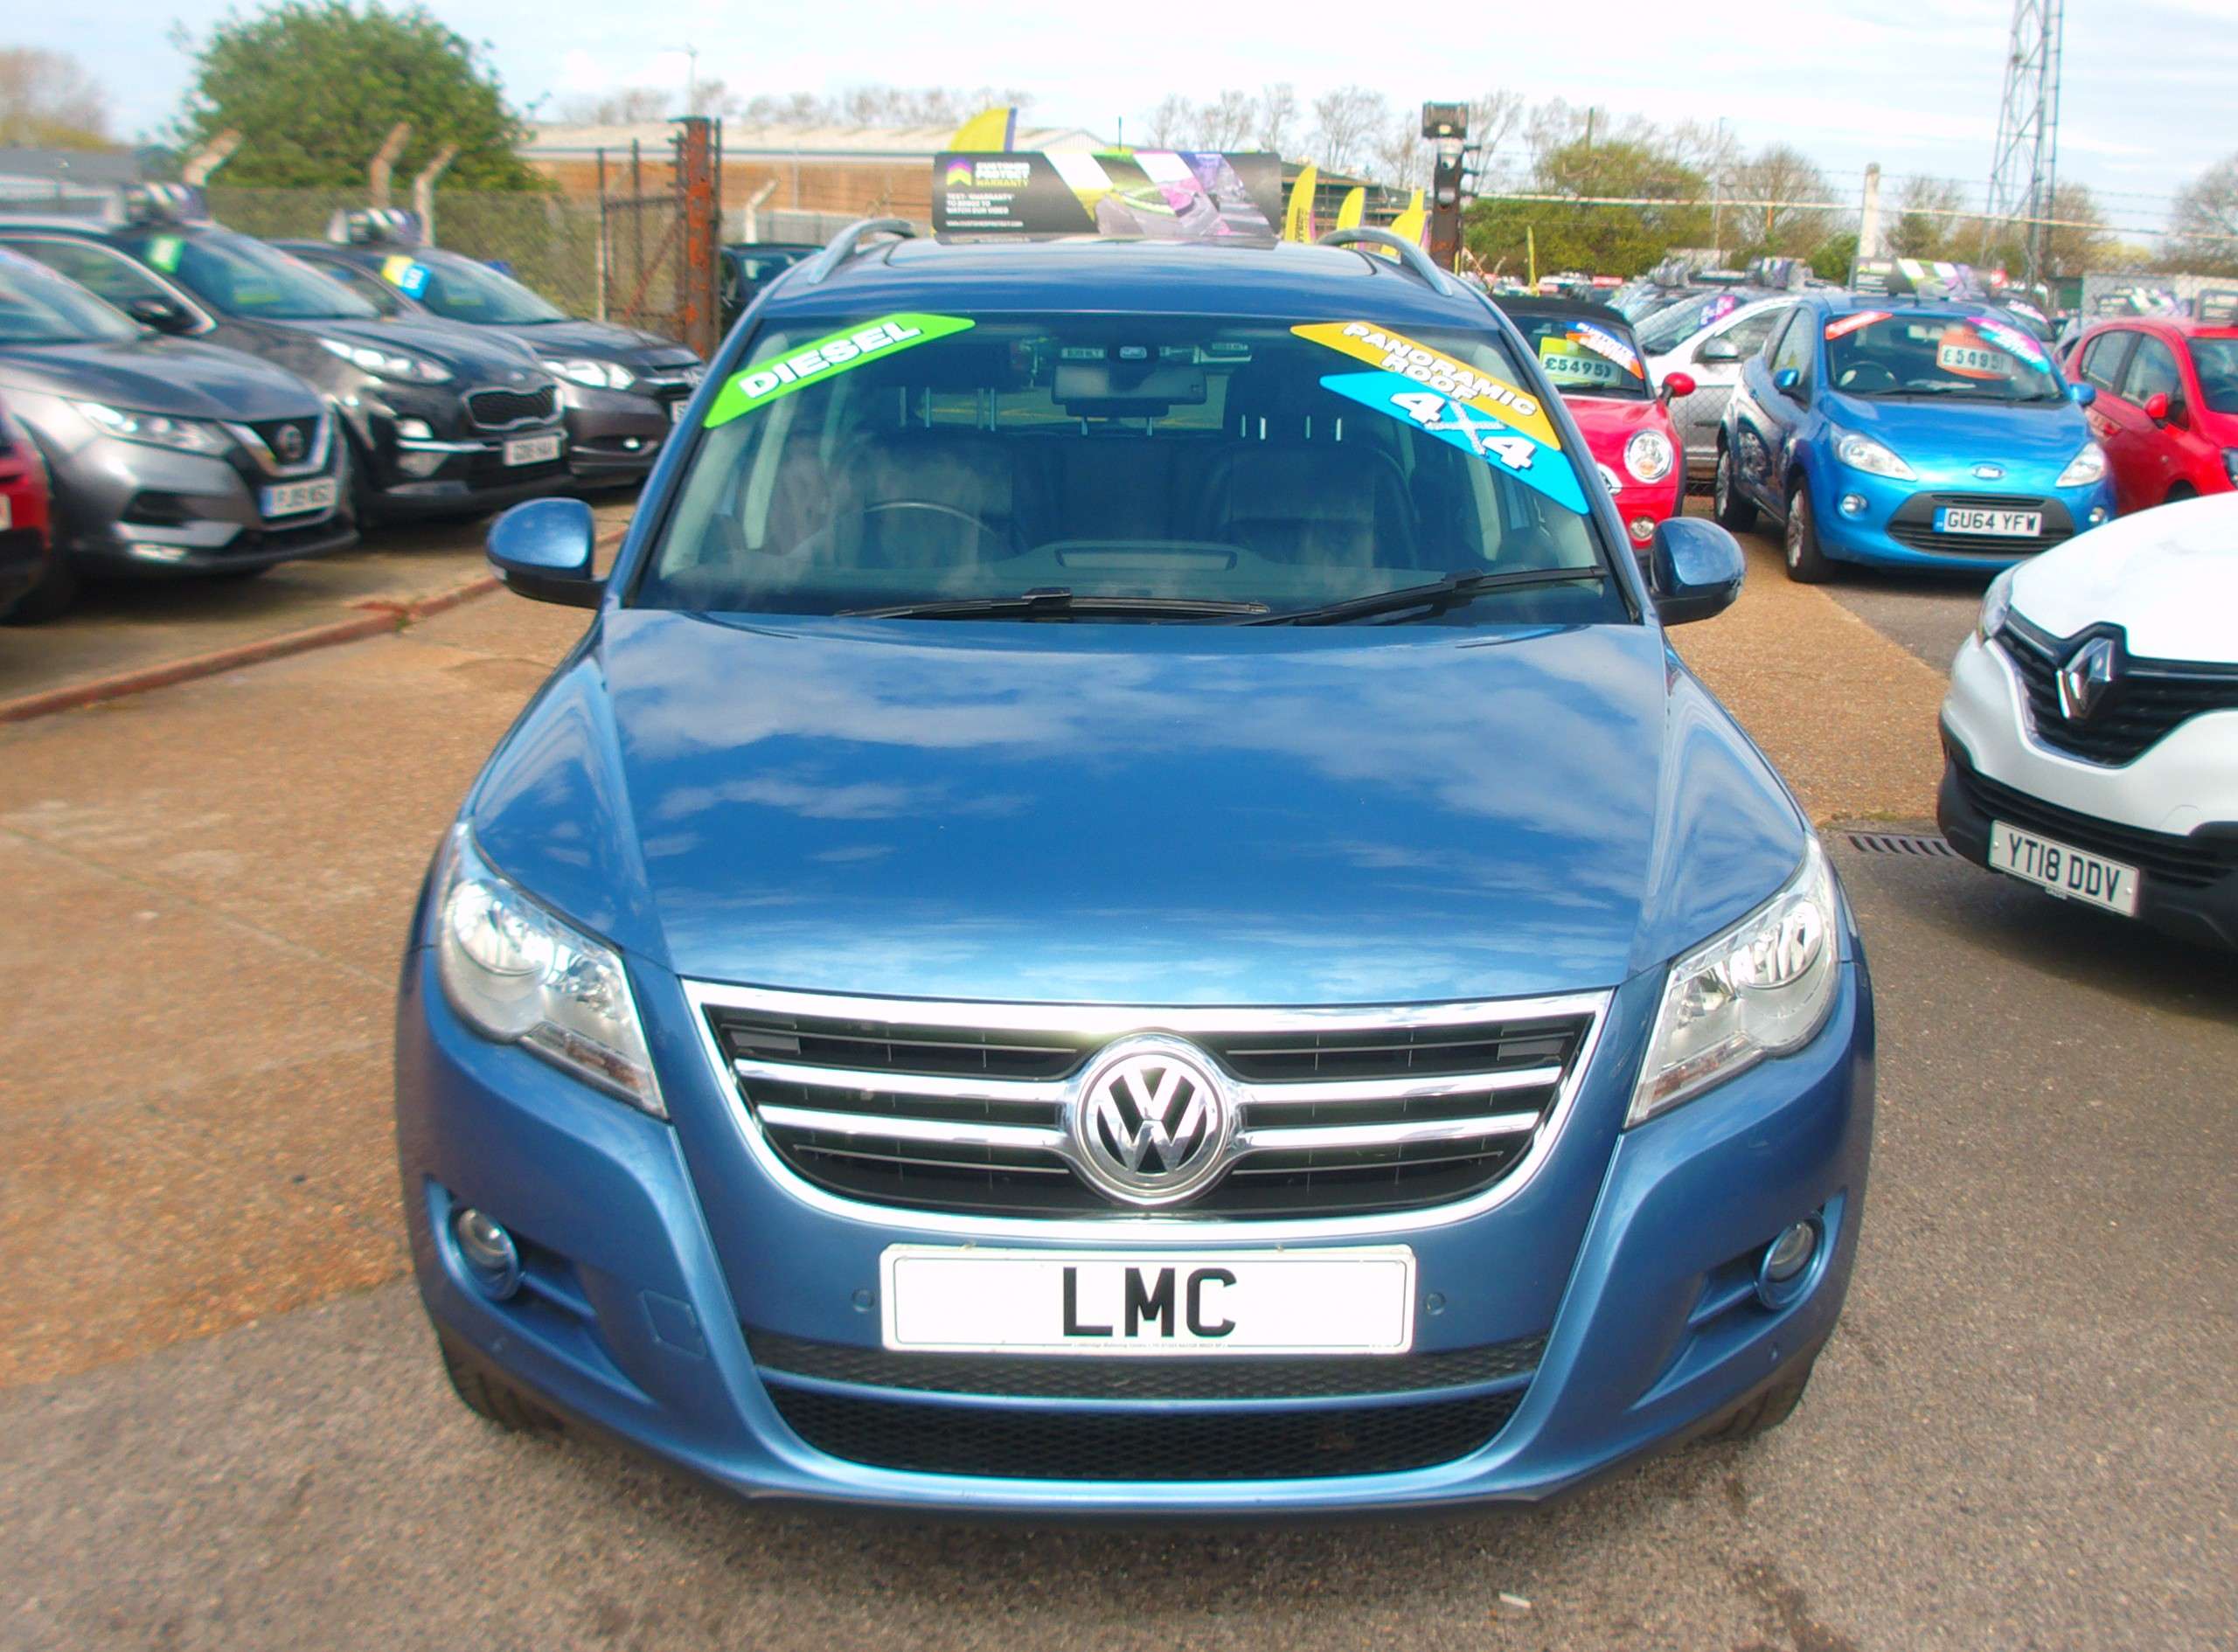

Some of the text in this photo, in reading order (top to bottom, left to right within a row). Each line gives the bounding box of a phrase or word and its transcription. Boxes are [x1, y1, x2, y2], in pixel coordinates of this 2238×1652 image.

[739, 322, 922, 399] DIESEL
[1343, 322, 1537, 416] PANORAMIC
[1380, 352, 1478, 401] ROOF
[1948, 511, 2036, 531] GU64 YFW
[2009, 833, 2121, 902] YT18 DDV
[1063, 1266, 1237, 1339] LMC
